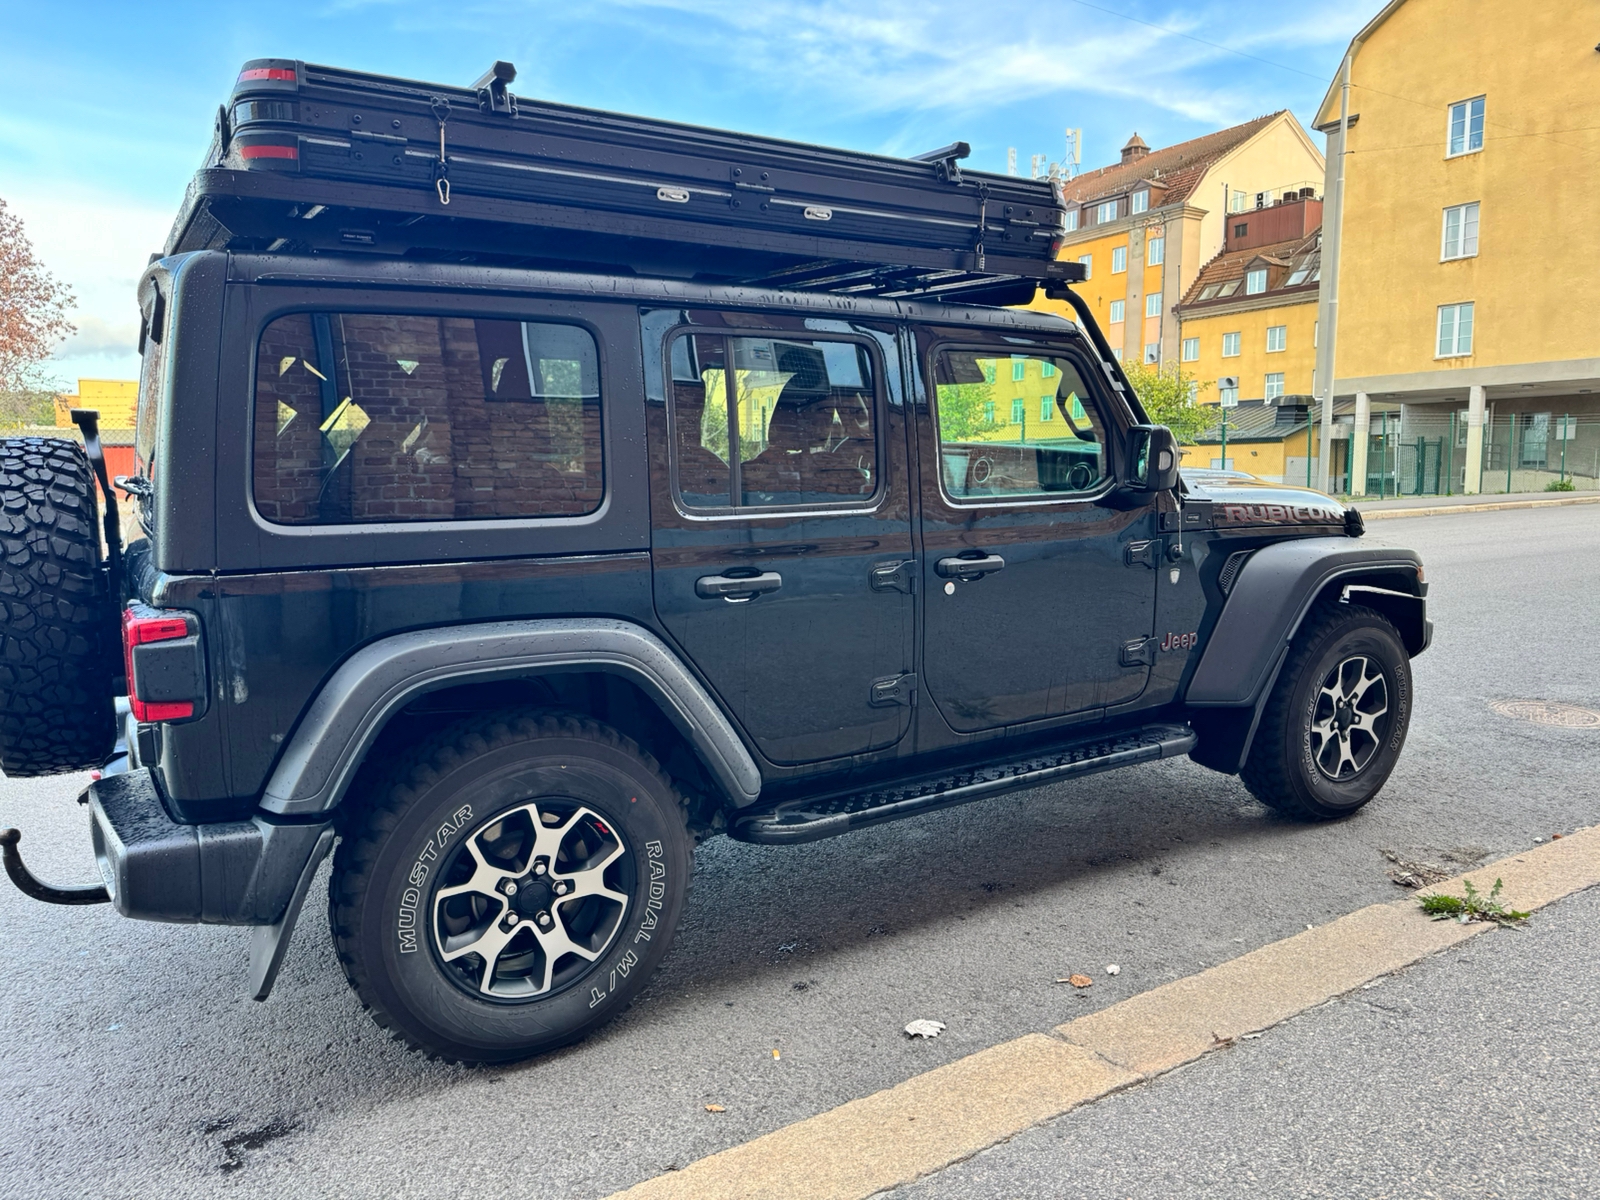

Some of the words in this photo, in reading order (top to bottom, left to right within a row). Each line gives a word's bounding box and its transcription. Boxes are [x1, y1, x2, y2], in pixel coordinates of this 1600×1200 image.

[1224, 504, 1342, 522] RUBICON
[1160, 631, 1198, 651] Jeep
[1390, 664, 1407, 751] MUDSTAR
[398, 804, 473, 953] MUDSTAR
[634, 840, 665, 943] RADIAL
[589, 950, 638, 1009] M/T
